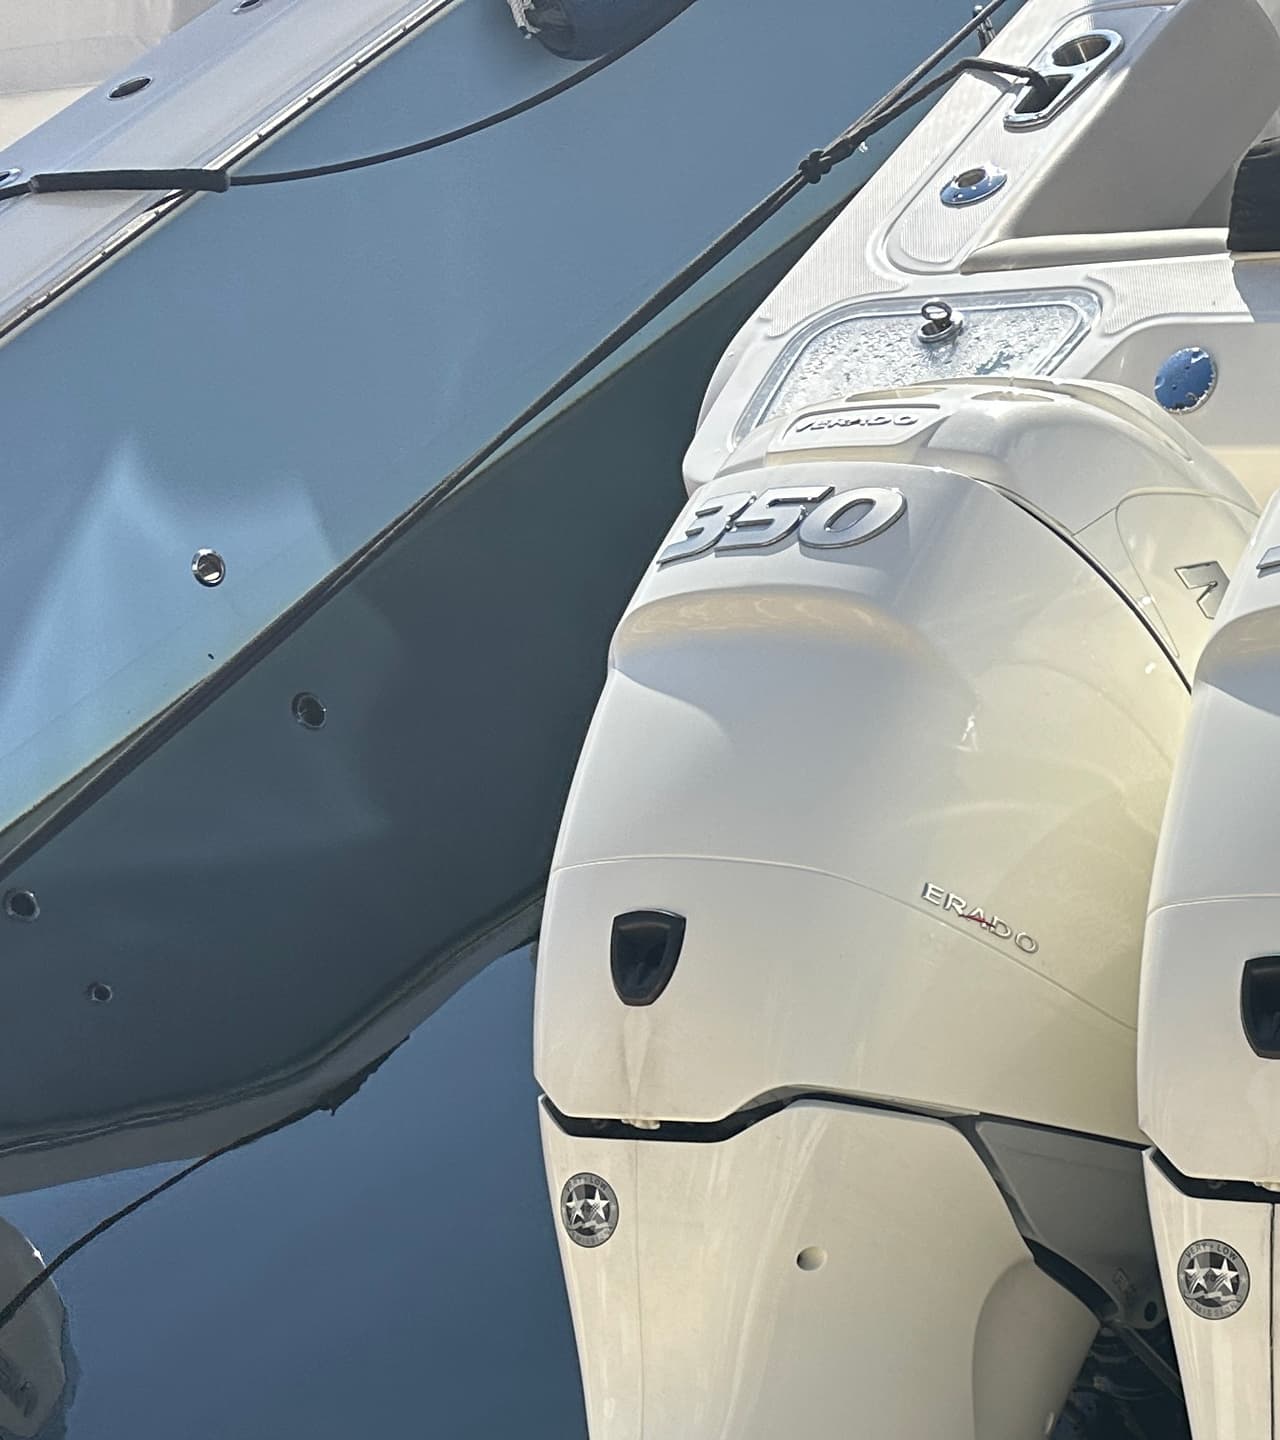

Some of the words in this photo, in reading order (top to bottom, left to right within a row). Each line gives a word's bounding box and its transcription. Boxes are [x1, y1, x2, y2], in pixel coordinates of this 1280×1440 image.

[795, 409, 919, 433] VERADO
[656, 484, 908, 567] 350
[921, 882, 1039, 954] ERADO
[1217, 1243, 1238, 1260] LOW
